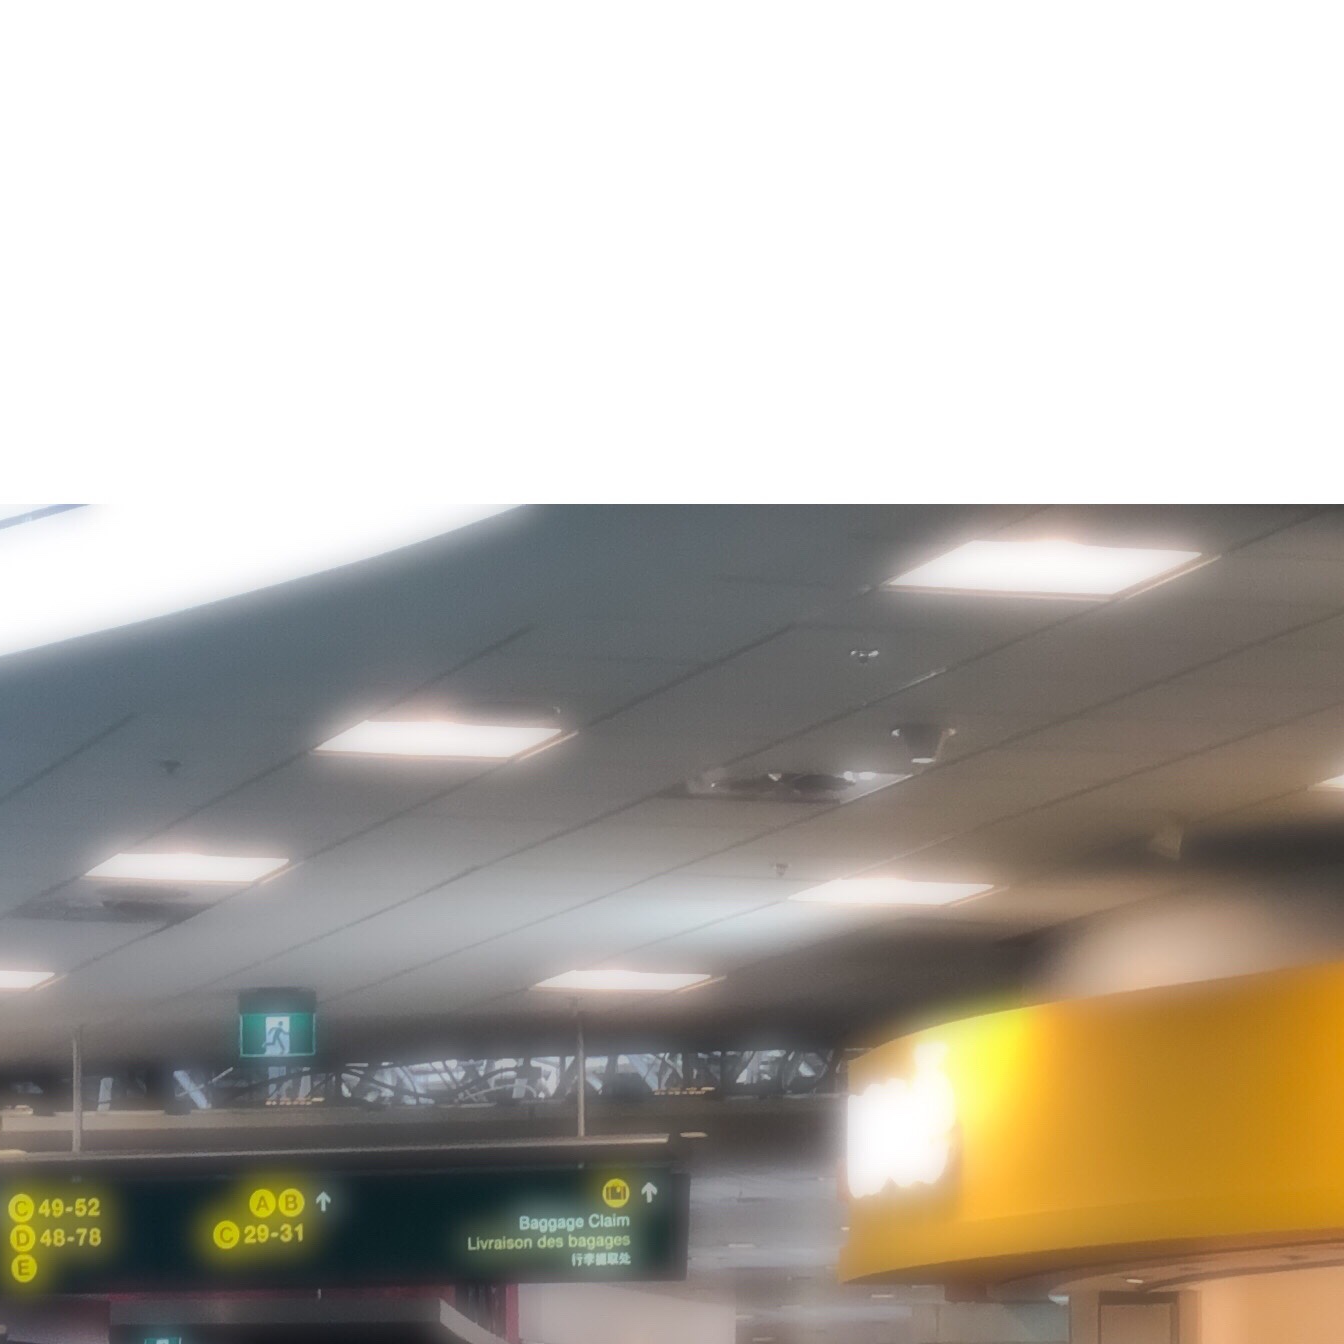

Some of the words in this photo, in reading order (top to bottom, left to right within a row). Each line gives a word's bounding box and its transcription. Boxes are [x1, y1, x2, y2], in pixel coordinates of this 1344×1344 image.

[38, 1198, 101, 1217] 49-52
[519, 1215, 584, 1233] Baggage
[588, 1213, 630, 1228] Claim
[39, 1228, 102, 1247] 48-78
[243, 1223, 304, 1244] 29-31
[467, 1235, 533, 1251] Livraison
[537, 1235, 564, 1249] des
[568, 1234, 631, 1250] bagages
